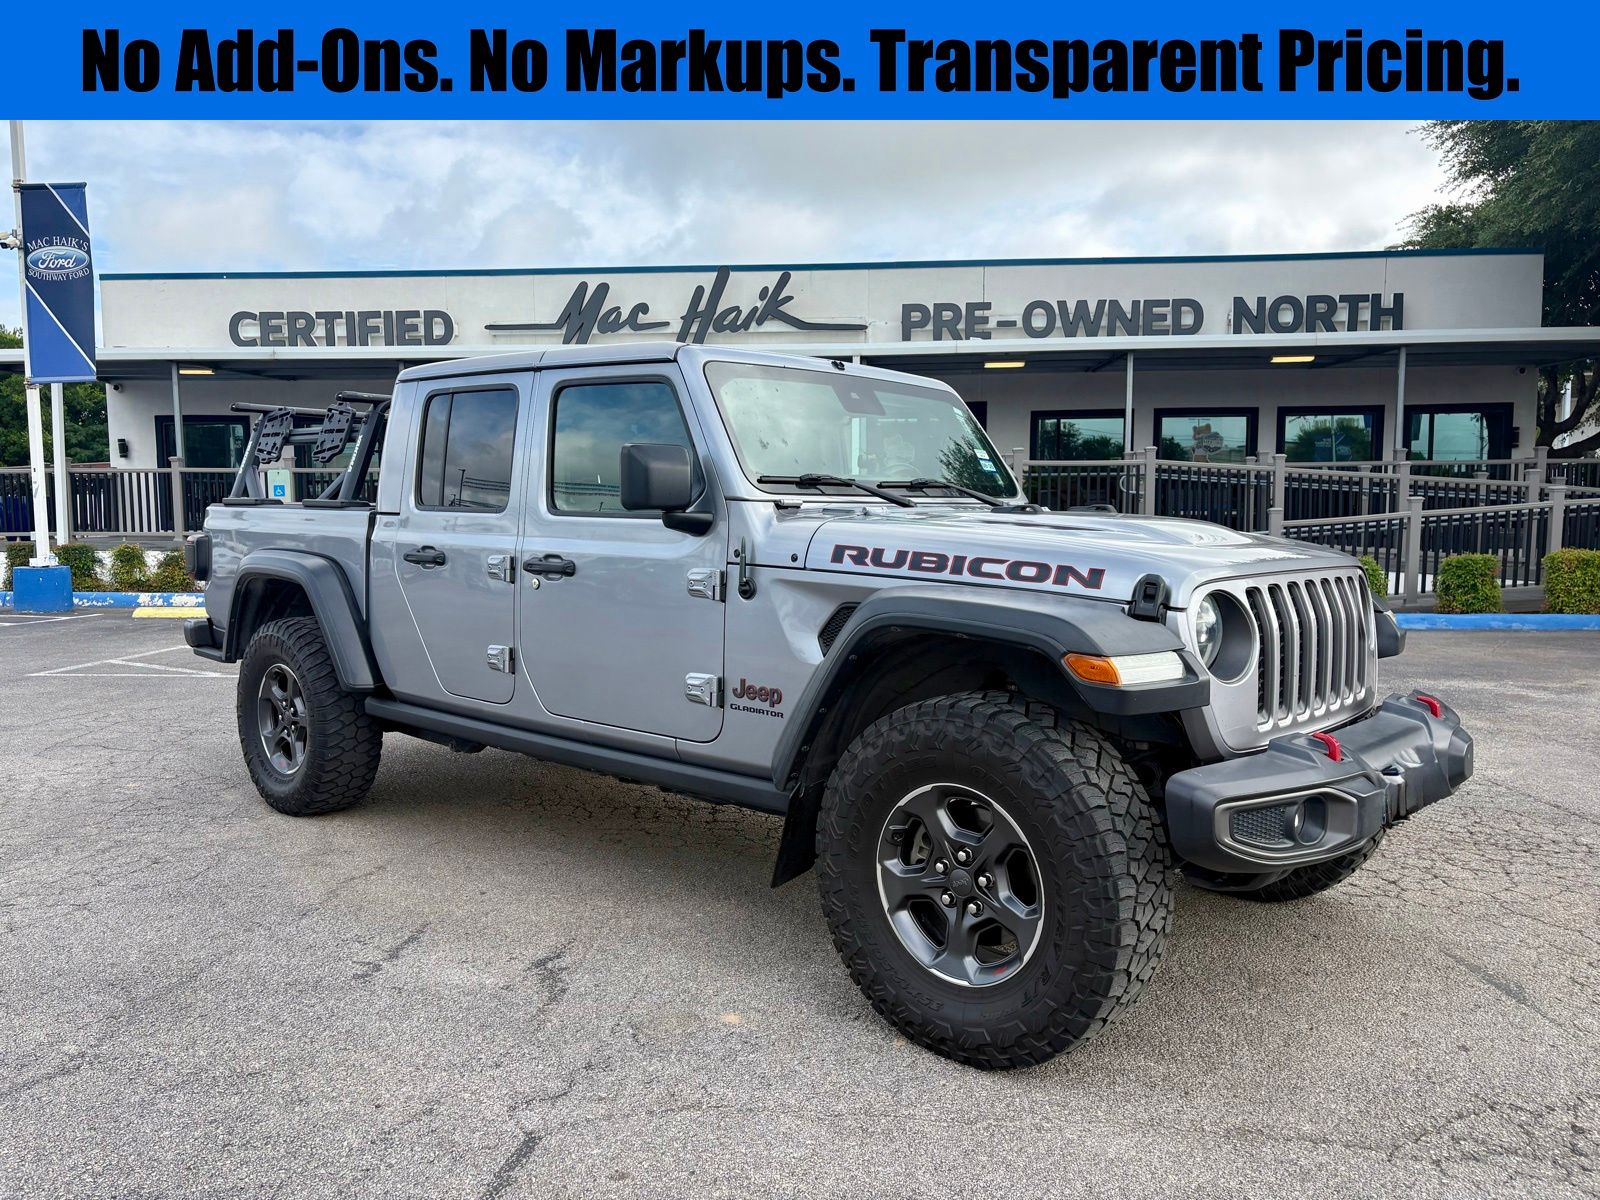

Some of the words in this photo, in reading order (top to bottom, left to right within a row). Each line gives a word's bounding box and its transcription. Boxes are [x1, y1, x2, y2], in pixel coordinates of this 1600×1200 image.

[27, 237, 50, 252] MAC
[53, 236, 89, 251] HAIK'S
[28, 268, 67, 281] SOUTHWAY
[69, 267, 90, 280] FORD
[38, 250, 77, 269] Ford
[484, 281, 670, 344] Mac
[676, 265, 868, 344] Haik
[901, 298, 1204, 341] PRE-OWNED
[1232, 293, 1405, 334] NORTH
[229, 310, 454, 347] CERTIFIED
[830, 544, 1106, 590] RUBICON
[732, 678, 783, 708] Jeep
[730, 703, 785, 719] GLADIATOR
